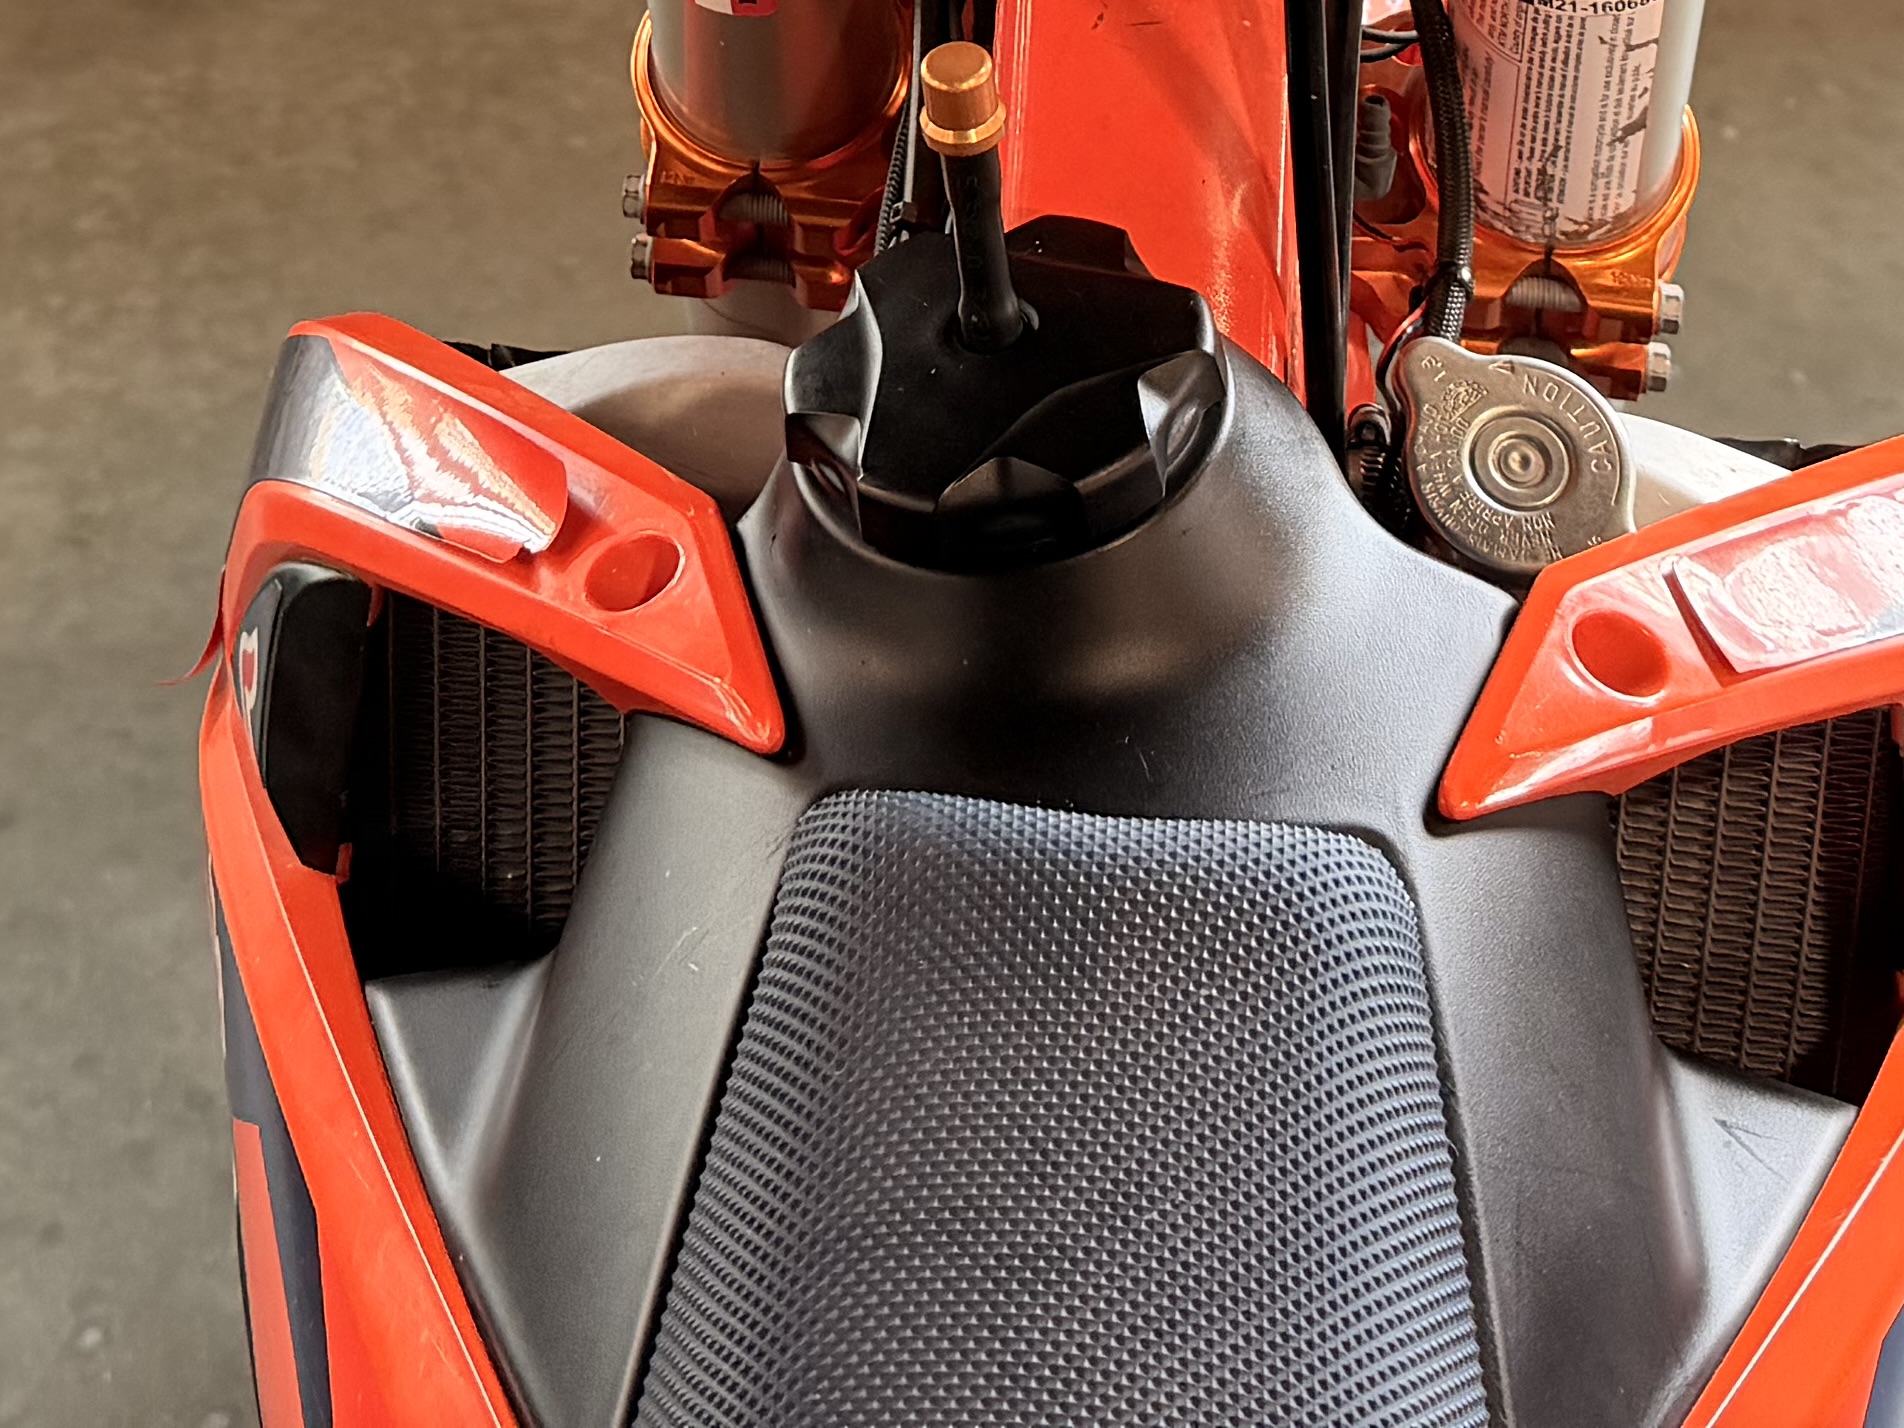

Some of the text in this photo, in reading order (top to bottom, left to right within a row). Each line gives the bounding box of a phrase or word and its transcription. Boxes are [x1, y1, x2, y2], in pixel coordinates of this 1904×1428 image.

[1523, 373, 1612, 474] CAUTION
[1459, 490, 1514, 527] APRIRE
[1521, 511, 1556, 532] NON
